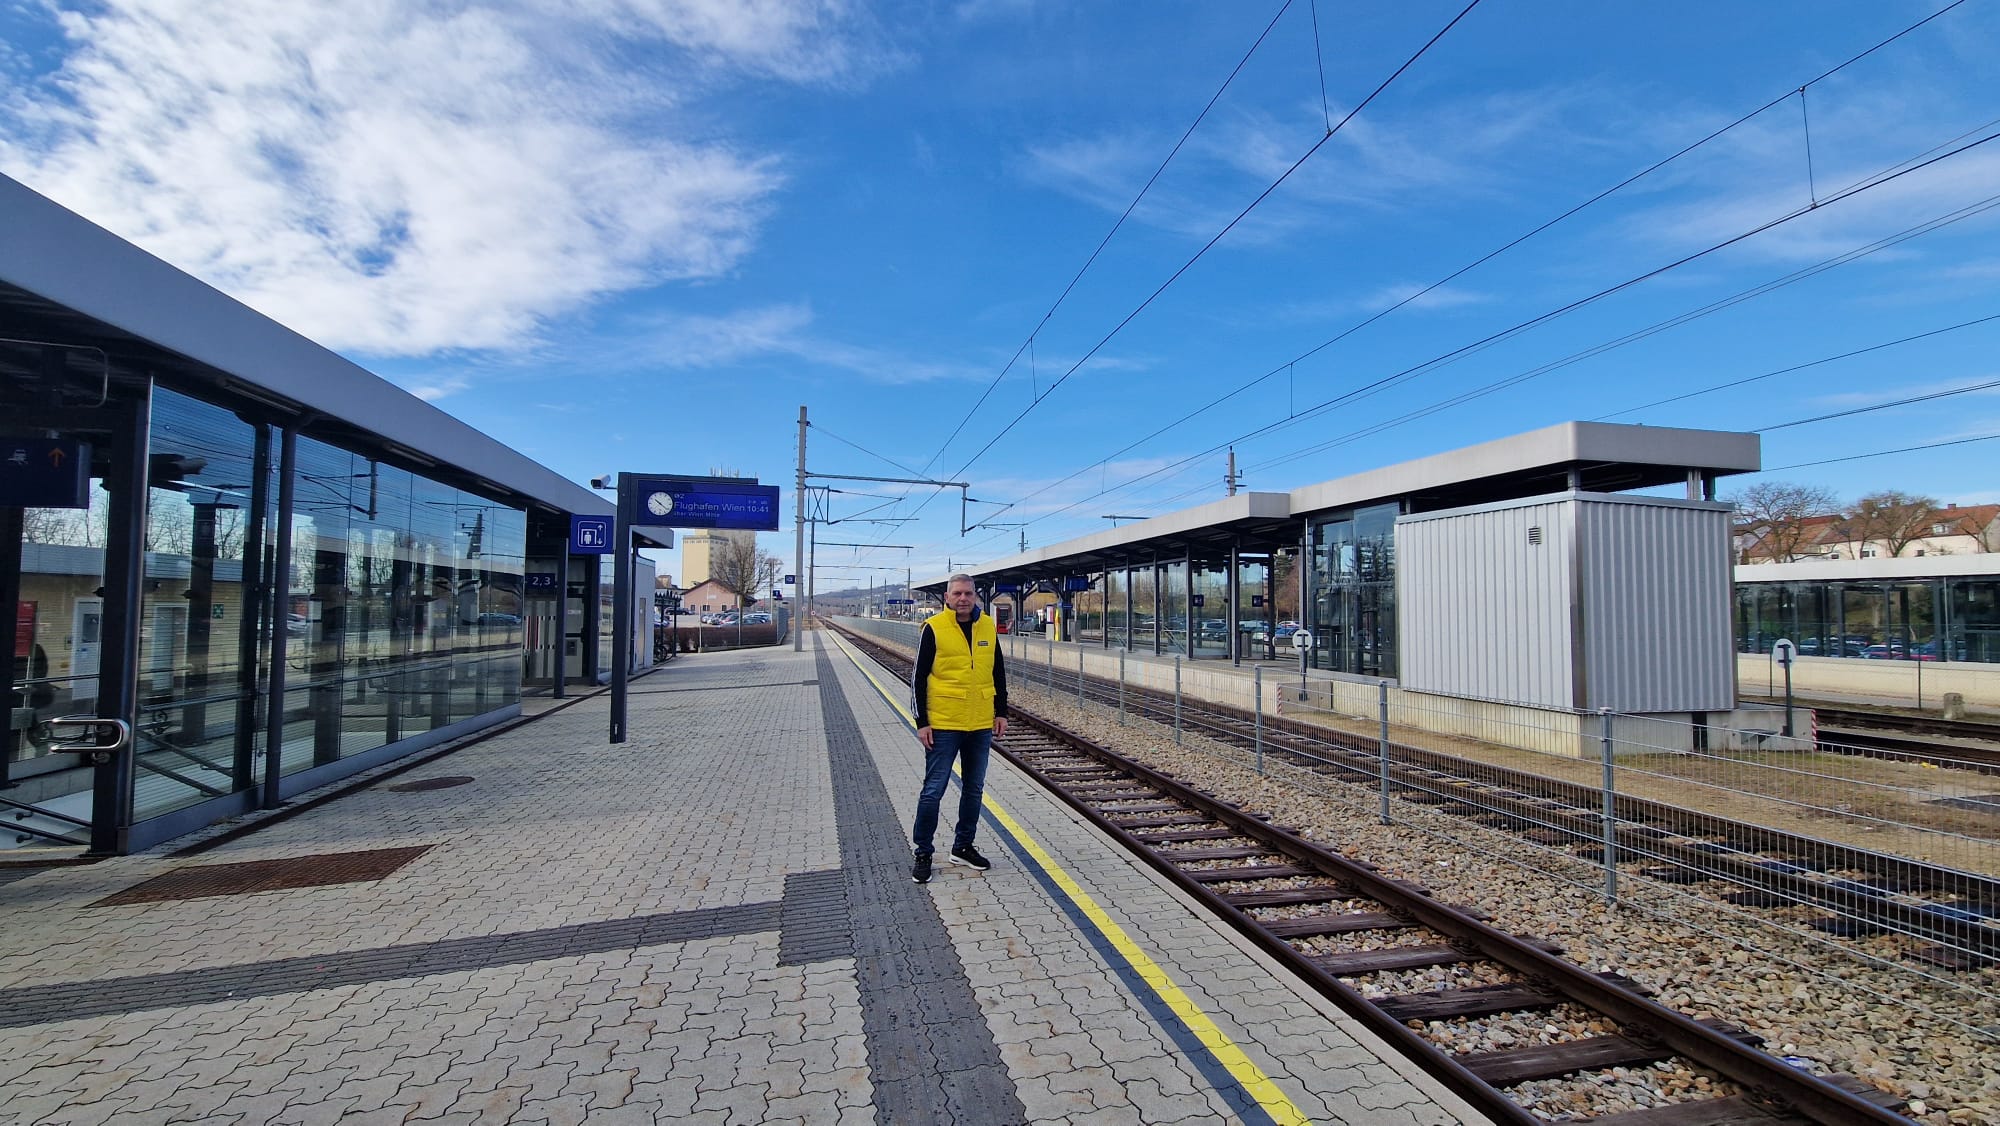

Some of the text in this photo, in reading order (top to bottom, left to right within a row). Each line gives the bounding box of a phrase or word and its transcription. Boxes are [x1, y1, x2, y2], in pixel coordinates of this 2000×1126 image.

[674, 501, 745, 512] Flughafen Wien
[748, 505, 769, 513] 10:41
[532, 576, 551, 587] 2,3
